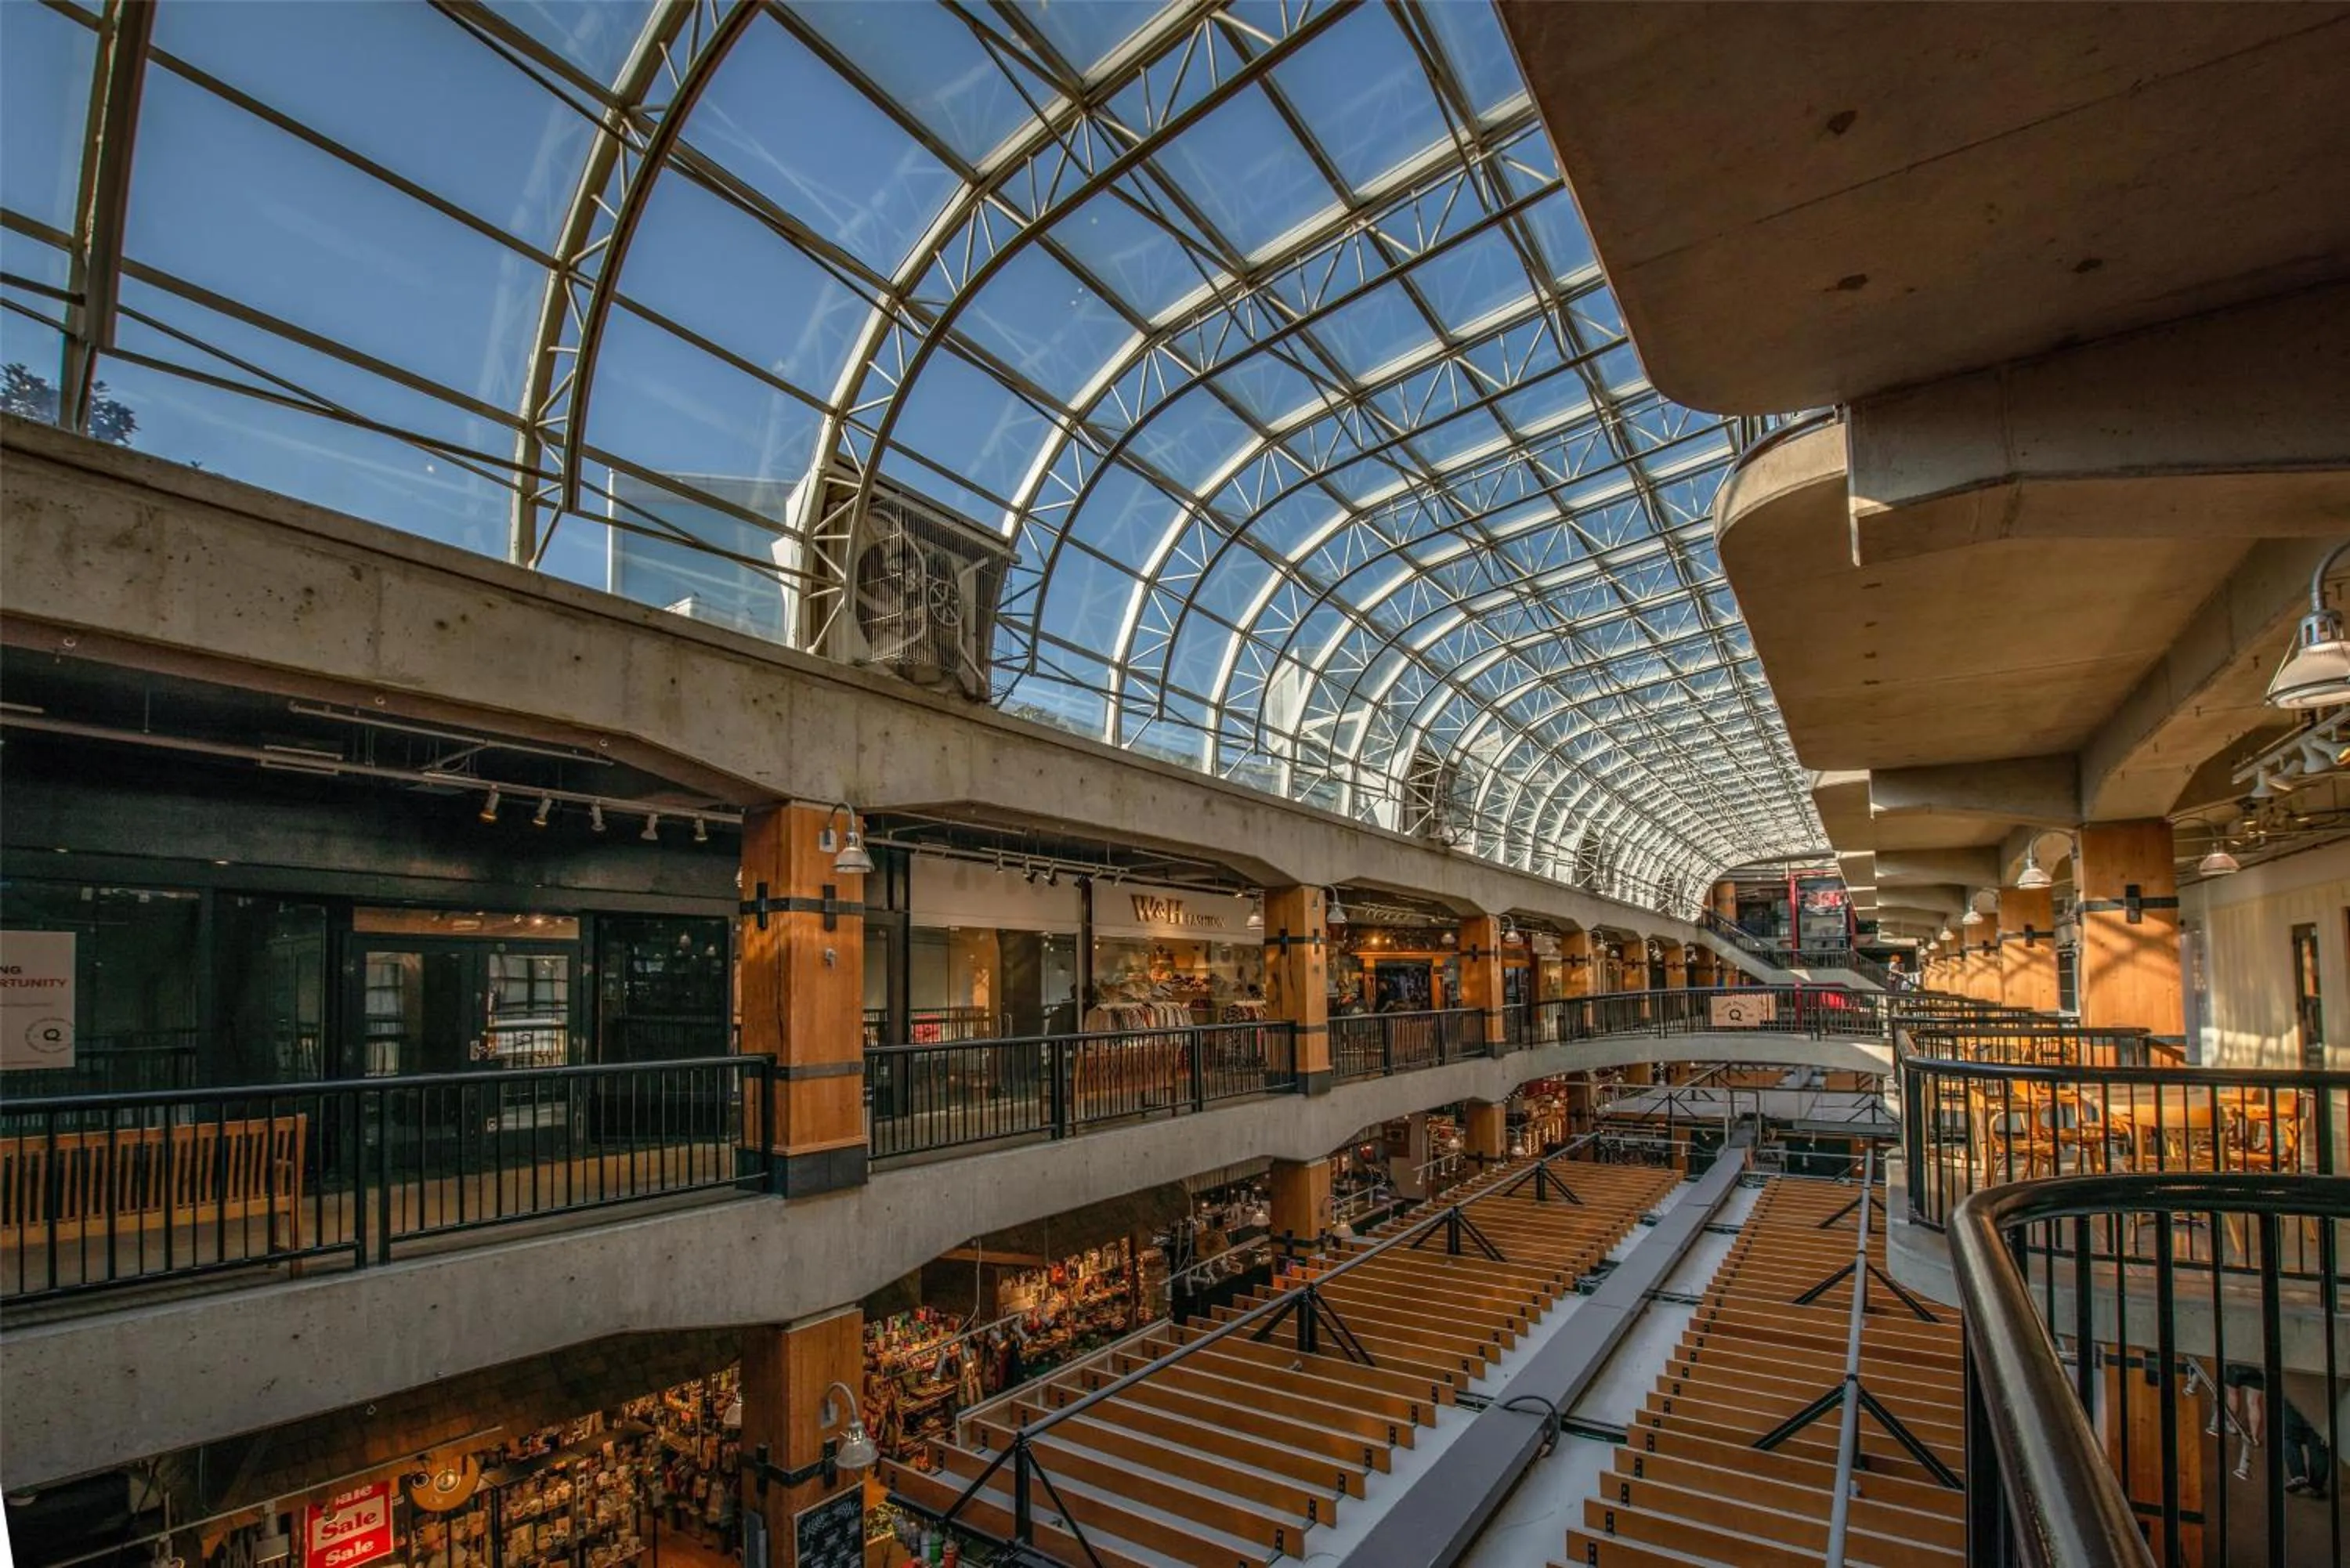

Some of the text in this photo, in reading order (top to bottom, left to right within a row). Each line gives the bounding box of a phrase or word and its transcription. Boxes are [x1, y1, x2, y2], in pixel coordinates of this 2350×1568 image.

[1130, 894, 1184, 925] W&H
[1729, 1009, 1743, 1021] Q
[43, 1028, 62, 1042] Q
[320, 1512, 377, 1541] Sale
[325, 1541, 374, 1567] Sale
